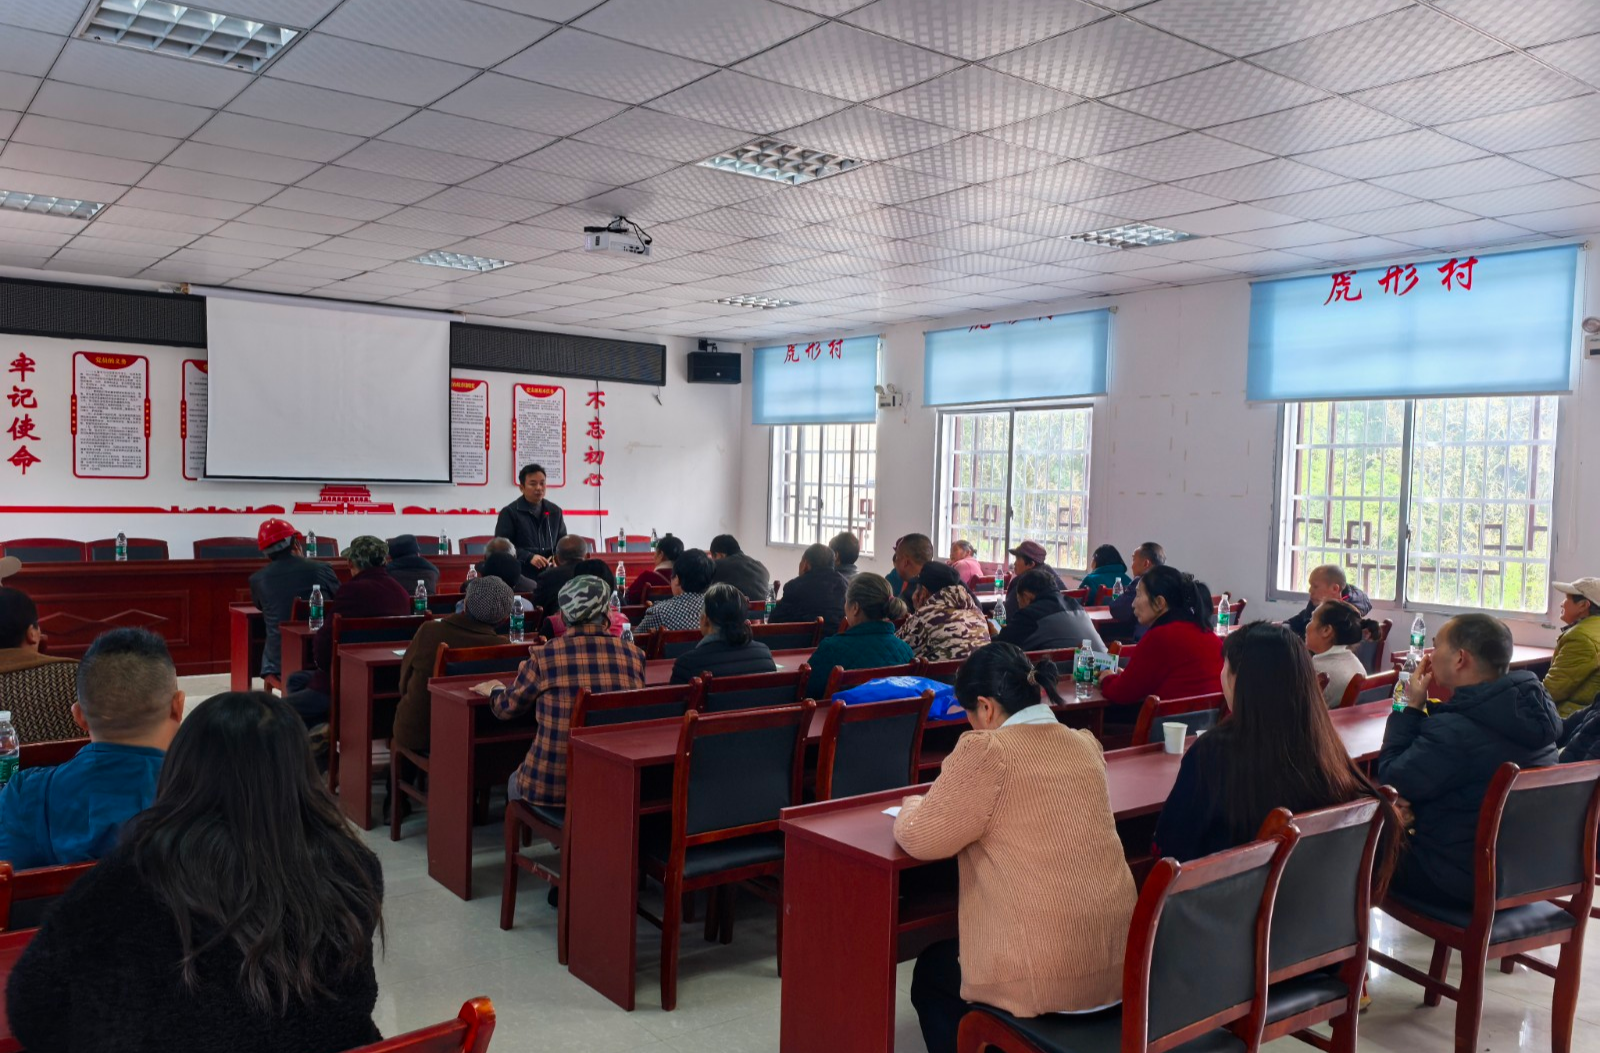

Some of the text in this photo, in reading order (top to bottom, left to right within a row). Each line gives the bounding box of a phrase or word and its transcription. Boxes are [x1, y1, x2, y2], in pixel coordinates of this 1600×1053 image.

[1323, 256, 1479, 306] 虎形村
[6, 351, 42, 475] 牢记使命
[584, 390, 606, 487] 不忘初心
